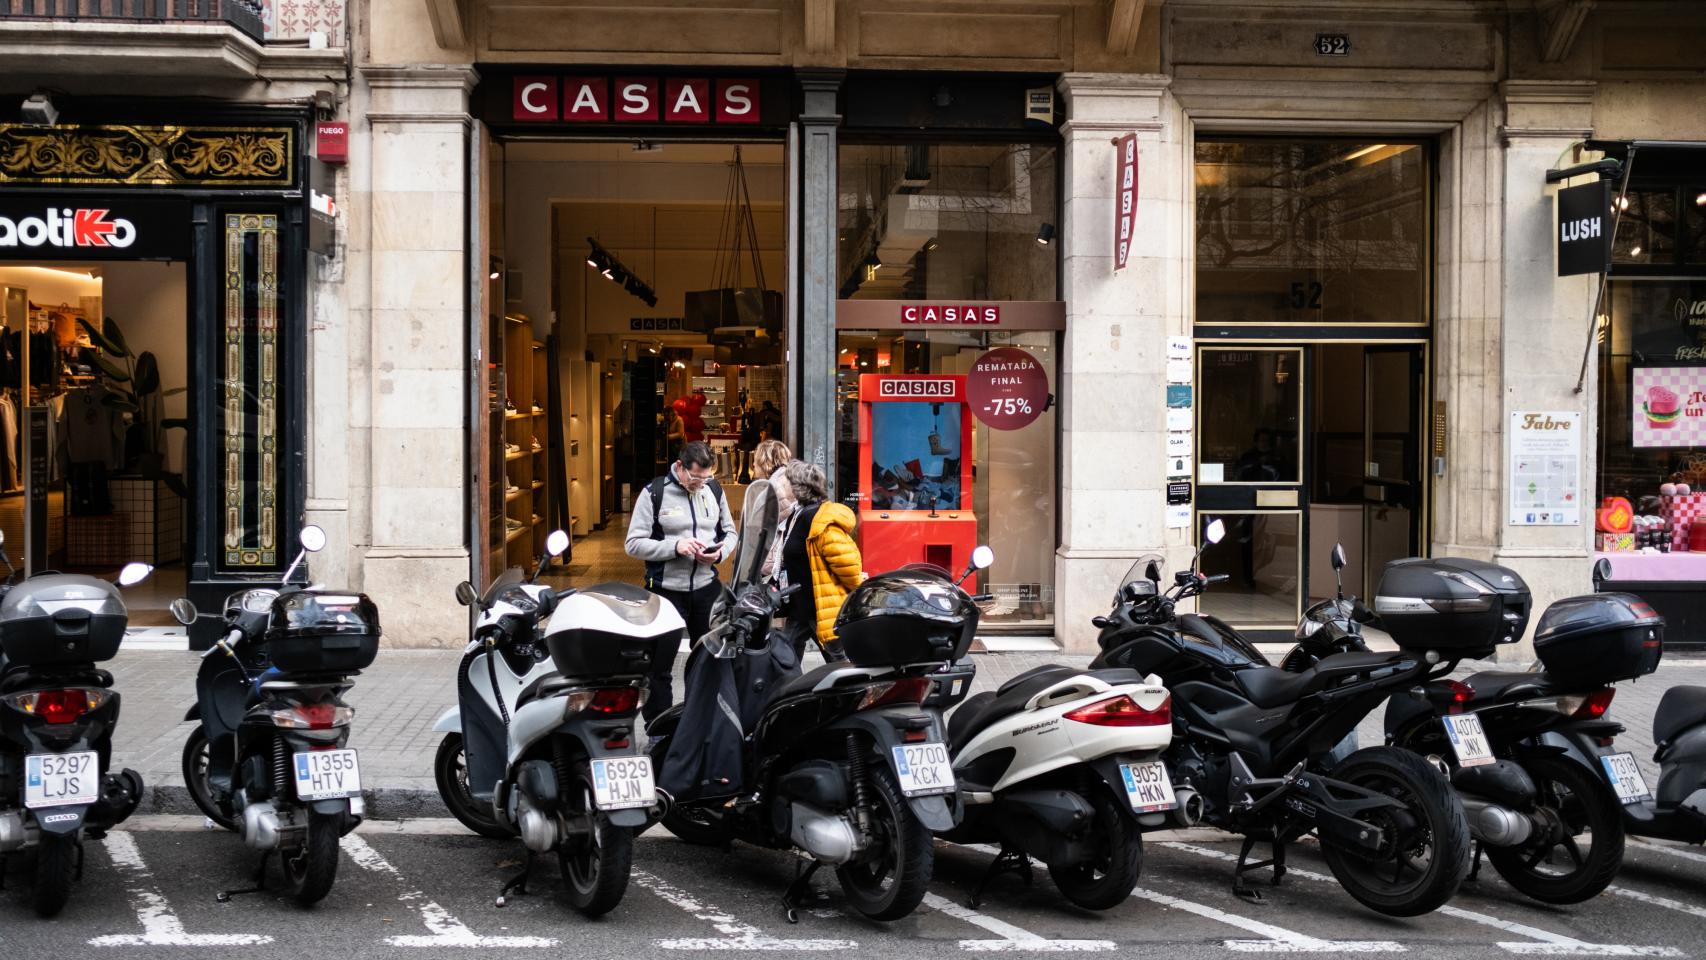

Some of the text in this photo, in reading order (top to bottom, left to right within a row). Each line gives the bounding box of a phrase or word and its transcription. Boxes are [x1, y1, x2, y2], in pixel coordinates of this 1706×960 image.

[1321, 37, 1345, 54] 52
[520, 82, 752, 115] CASAS
[1119, 143, 1134, 262] CASAS
[1561, 216, 1601, 242] LUSH
[1290, 281, 1323, 310] 52
[904, 307, 997, 321] CASAS
[631, 319, 680, 329] CASA
[977, 361, 1035, 372] REMATADA
[883, 382, 952, 394] CASAS
[991, 376, 1023, 386] FINAL
[983, 397, 1033, 416] -75%
[1685, 406, 1703, 417] un
[1521, 413, 1572, 431] Fabre
[1454, 718, 1482, 737] 4070
[906, 746, 946, 766] 2700
[1464, 737, 1483, 756] JNX
[43, 755, 91, 776] 5297
[312, 753, 354, 772] 1355
[606, 760, 649, 780] 6929
[1610, 756, 1637, 775] 7318
[312, 772, 344, 791] HTV
[911, 766, 941, 785] KCK
[1132, 764, 1163, 784] 9057
[43, 777, 80, 797] LJS
[609, 780, 642, 800] HJN
[1137, 784, 1166, 802] HKN
[1619, 776, 1640, 794] FDC
